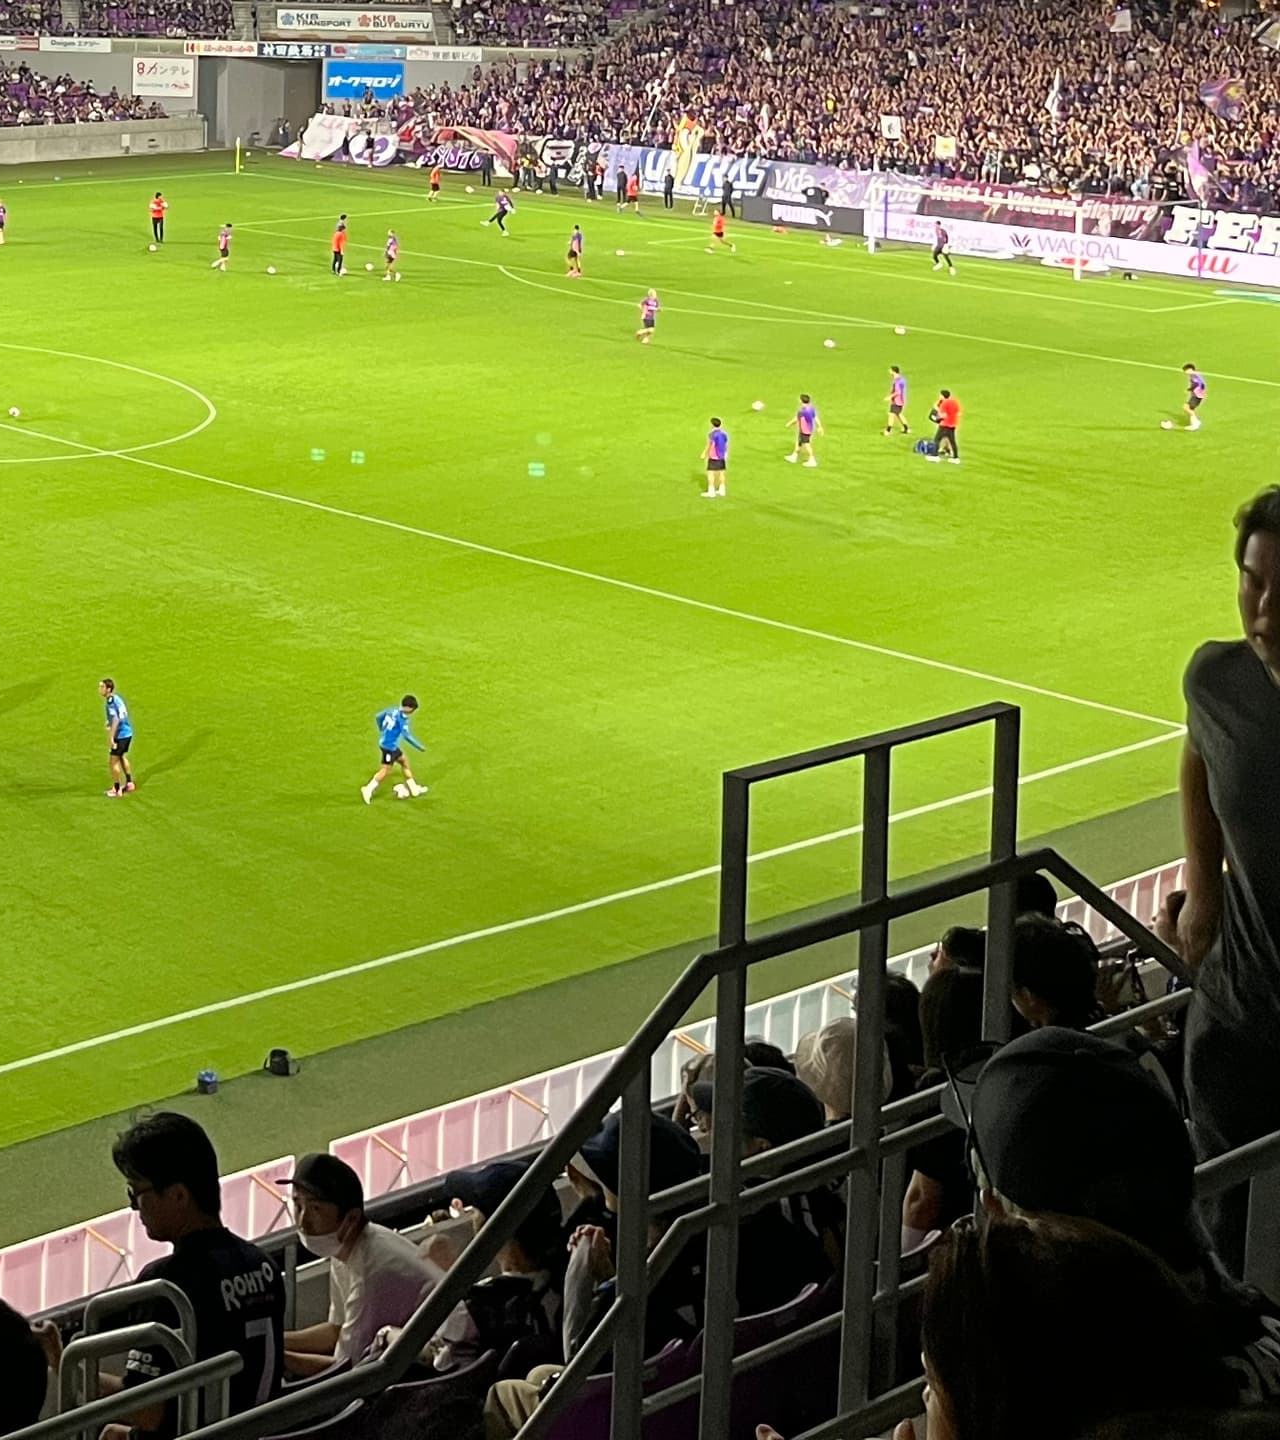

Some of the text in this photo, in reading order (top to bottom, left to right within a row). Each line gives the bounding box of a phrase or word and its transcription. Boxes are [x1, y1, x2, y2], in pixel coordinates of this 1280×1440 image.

[297, 19, 351, 27] TRANSPORT
[373, 21, 430, 30] BUTSURYU
[1187, 252, 1239, 274] au
[220, 1261, 274, 1312] ROHTO
[244, 1316, 276, 1408] 7
